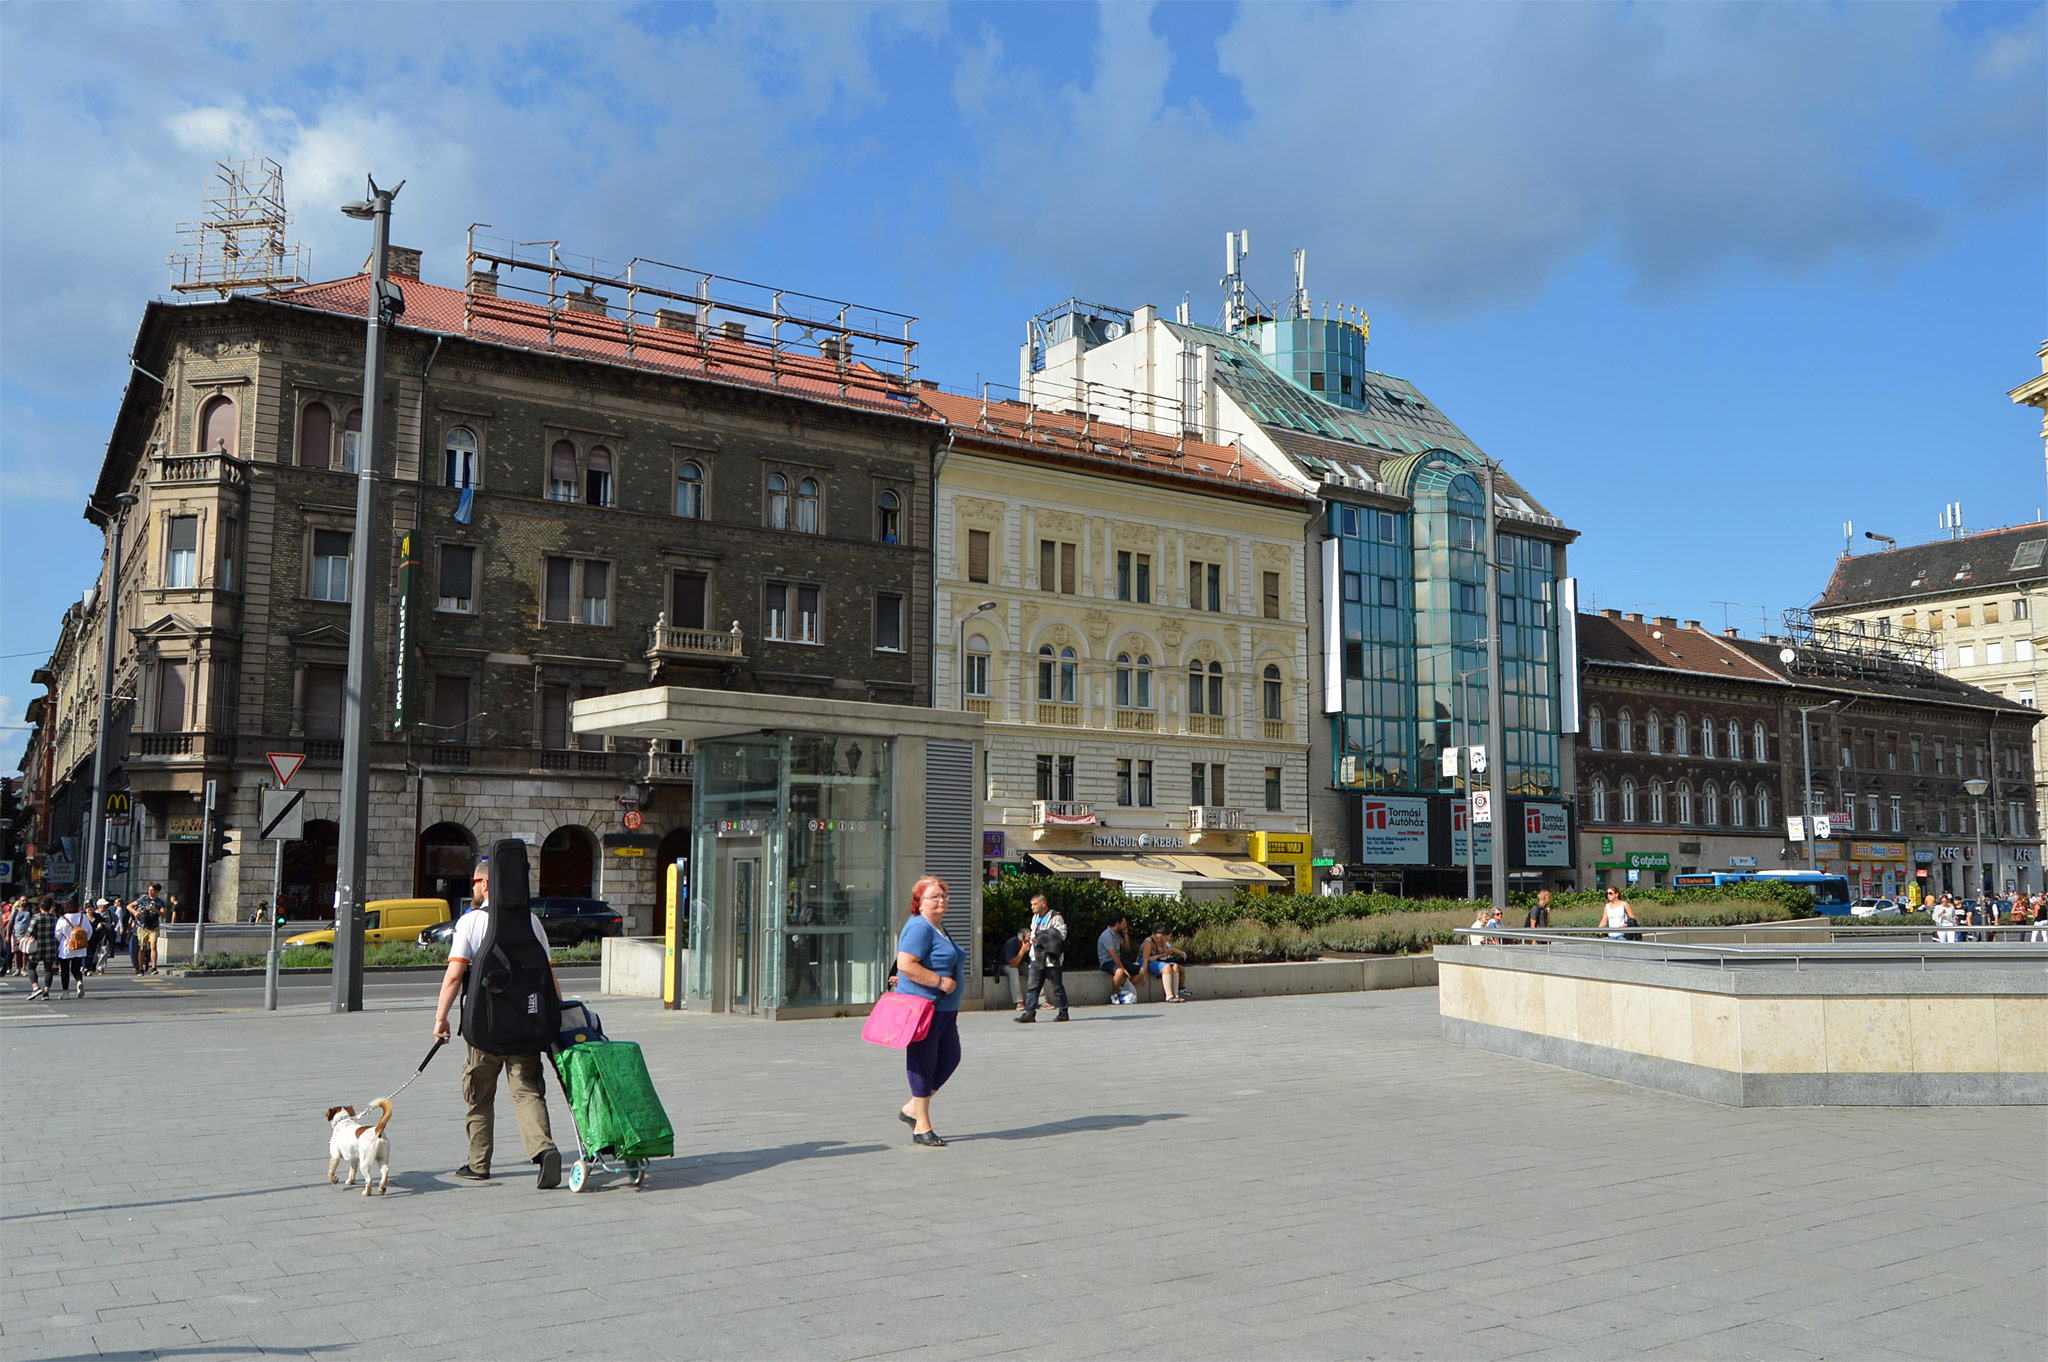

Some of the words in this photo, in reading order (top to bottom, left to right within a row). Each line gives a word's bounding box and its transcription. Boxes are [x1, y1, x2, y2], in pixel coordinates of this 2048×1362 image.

[396, 595, 406, 710] McDonald's
[1388, 807, 1421, 817] Tormási
[1541, 813, 1564, 822] Tormási
[1388, 817, 1424, 827] Autóház
[1542, 822, 1566, 831] Autóház
[1092, 835, 1137, 847] ISTANBUL
[1152, 836, 1184, 848] KEBAB
[1939, 846, 1960, 859] KFC
[2015, 848, 2033, 860] KFC
